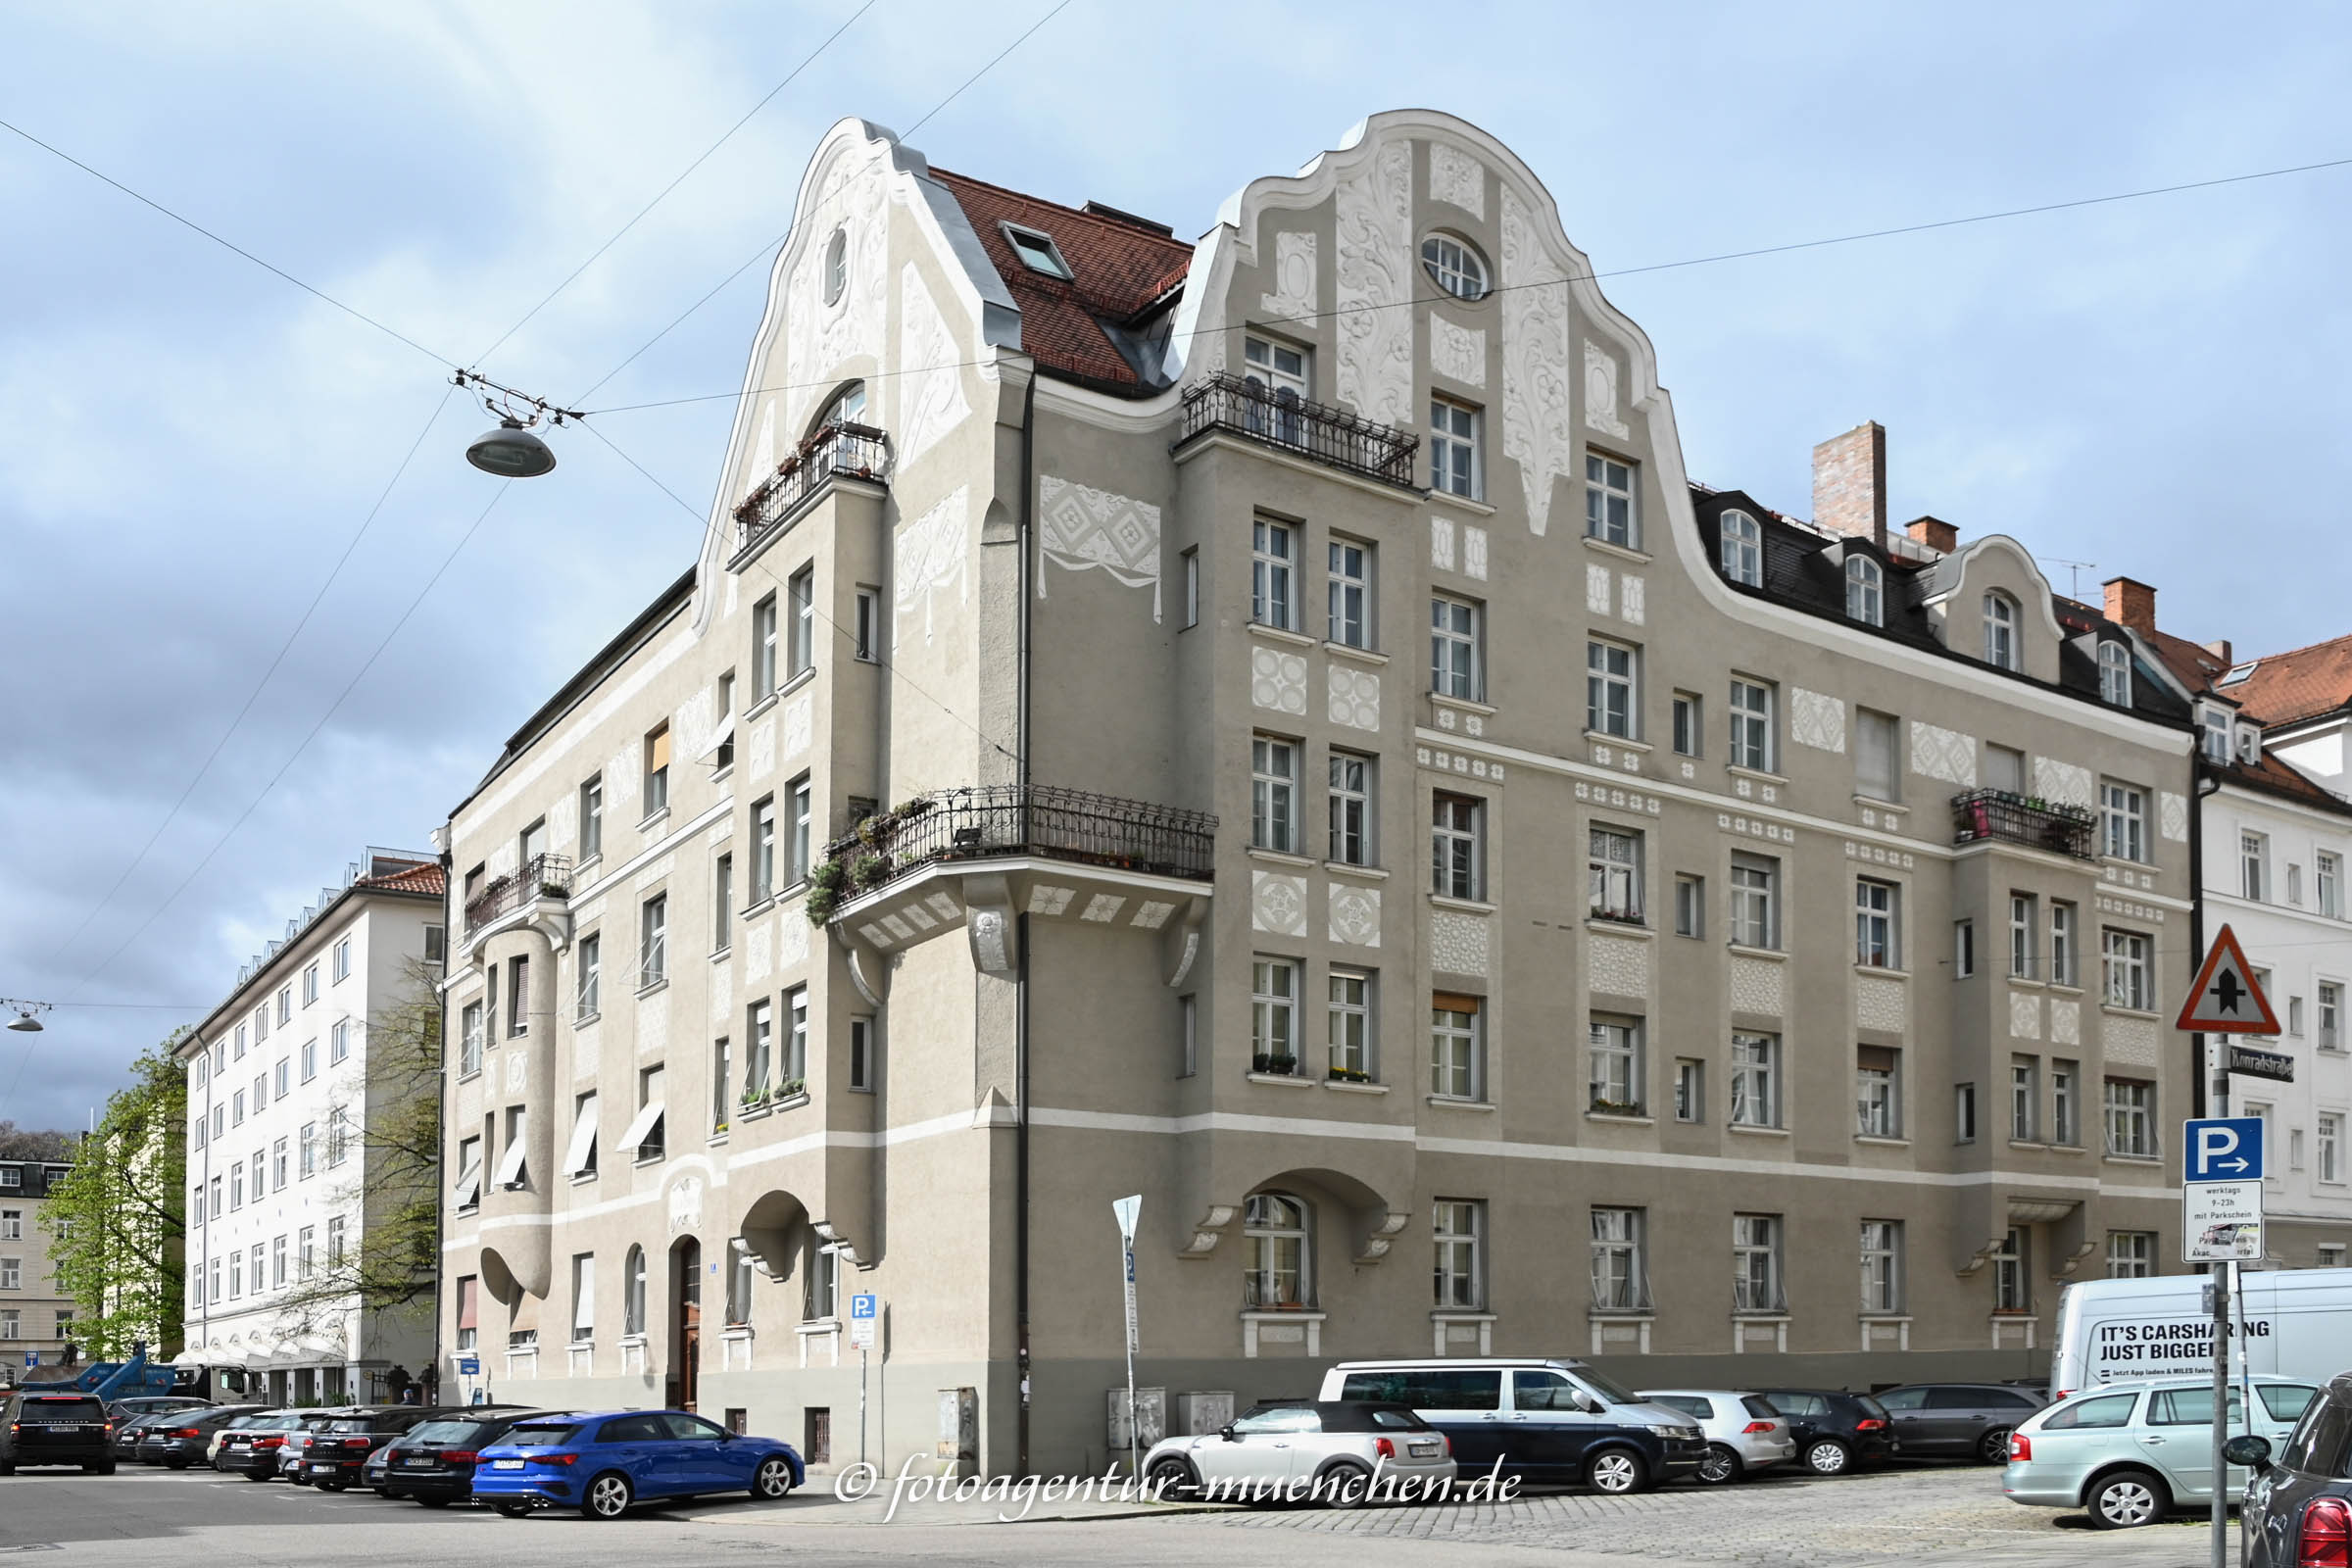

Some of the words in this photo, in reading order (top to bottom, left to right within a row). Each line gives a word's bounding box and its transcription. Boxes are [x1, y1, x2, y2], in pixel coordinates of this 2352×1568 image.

[2231, 1050, 2293, 1076] Konradstraße
[2197, 1126, 2239, 1174] P
[2206, 1187, 2241, 1196] werktags
[2211, 1199, 2235, 1207] 9-23h
[855, 1297, 869, 1317] P
[2101, 1326, 2137, 1342] IT'S
[2101, 1345, 2144, 1361] JUST
